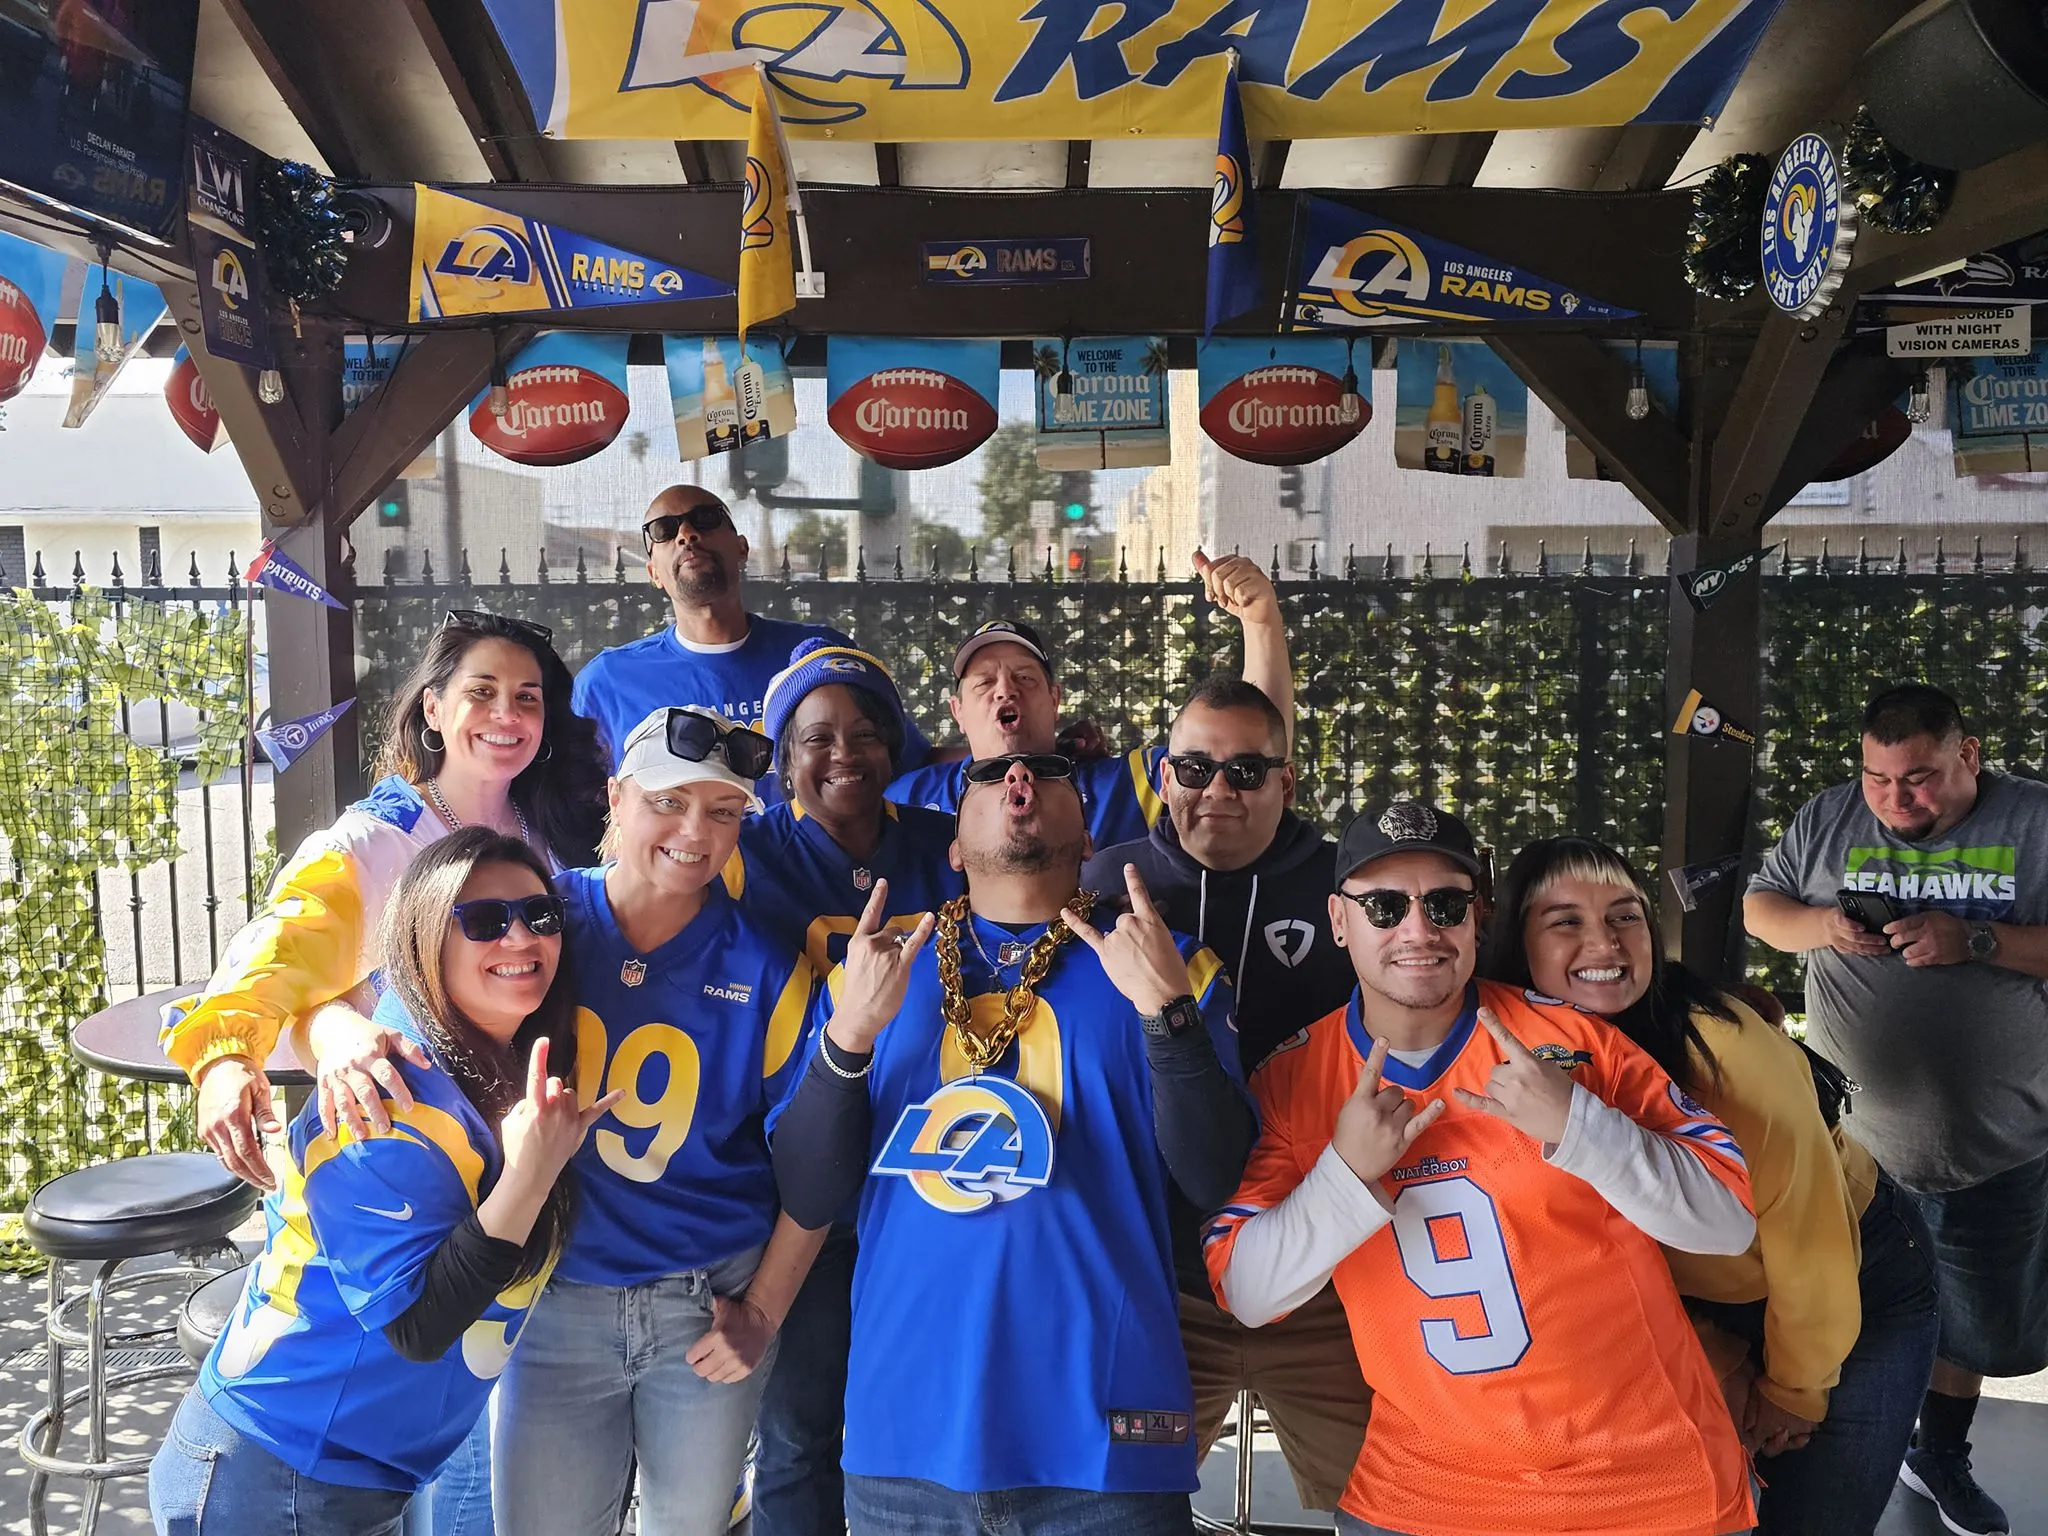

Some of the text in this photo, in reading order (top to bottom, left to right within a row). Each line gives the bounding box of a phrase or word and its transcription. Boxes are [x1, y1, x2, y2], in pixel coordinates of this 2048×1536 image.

[992, 0, 1698, 102] RAMS
[88, 132, 136, 161] DECLAN FARMER
[1763, 138, 1837, 256] LOS ANGELES RAMS
[198, 195, 245, 226] CHAMPIONS
[571, 252, 645, 290] RAMS
[997, 248, 1057, 273] RAMS
[1444, 261, 1513, 283] LOS ANGELES
[1440, 276, 1552, 311] RAMS
[1773, 256, 1823, 306] EST. 1937
[1946, 308, 2014, 320] ORDED
[1916, 324, 2002, 335] WITH NIGHT
[1077, 349, 1123, 362] WELCOME
[1898, 338, 2020, 351] VISION CAMERAS
[1084, 361, 1117, 373] TO THE
[1993, 353, 2042, 366] WELCOME
[2002, 365, 2037, 377] TO THE
[352, 370, 383, 381] TO THE
[743, 372, 757, 420] Corona
[1965, 374, 2048, 408] Coro
[496, 398, 606, 439] Corona
[706, 408, 736, 421] Corona
[855, 397, 969, 440] Corona
[1054, 398, 1152, 423] ME ZONE
[1228, 398, 1341, 436] Corona
[1971, 402, 2048, 429] LIME ZO
[1429, 428, 1460, 441] Corona
[1470, 402, 1485, 451] Corona
[262, 559, 322, 601] PATRIOTS
[1695, 571, 1722, 595] NY
[1722, 722, 1756, 744] Steelers
[1843, 871, 2016, 901] SEAHAWKS
[703, 984, 750, 1003] RAMS
[1393, 1158, 1468, 1180] WATERBOY
[1391, 1176, 1533, 1376] 9
[1152, 1415, 1168, 1428] XL
